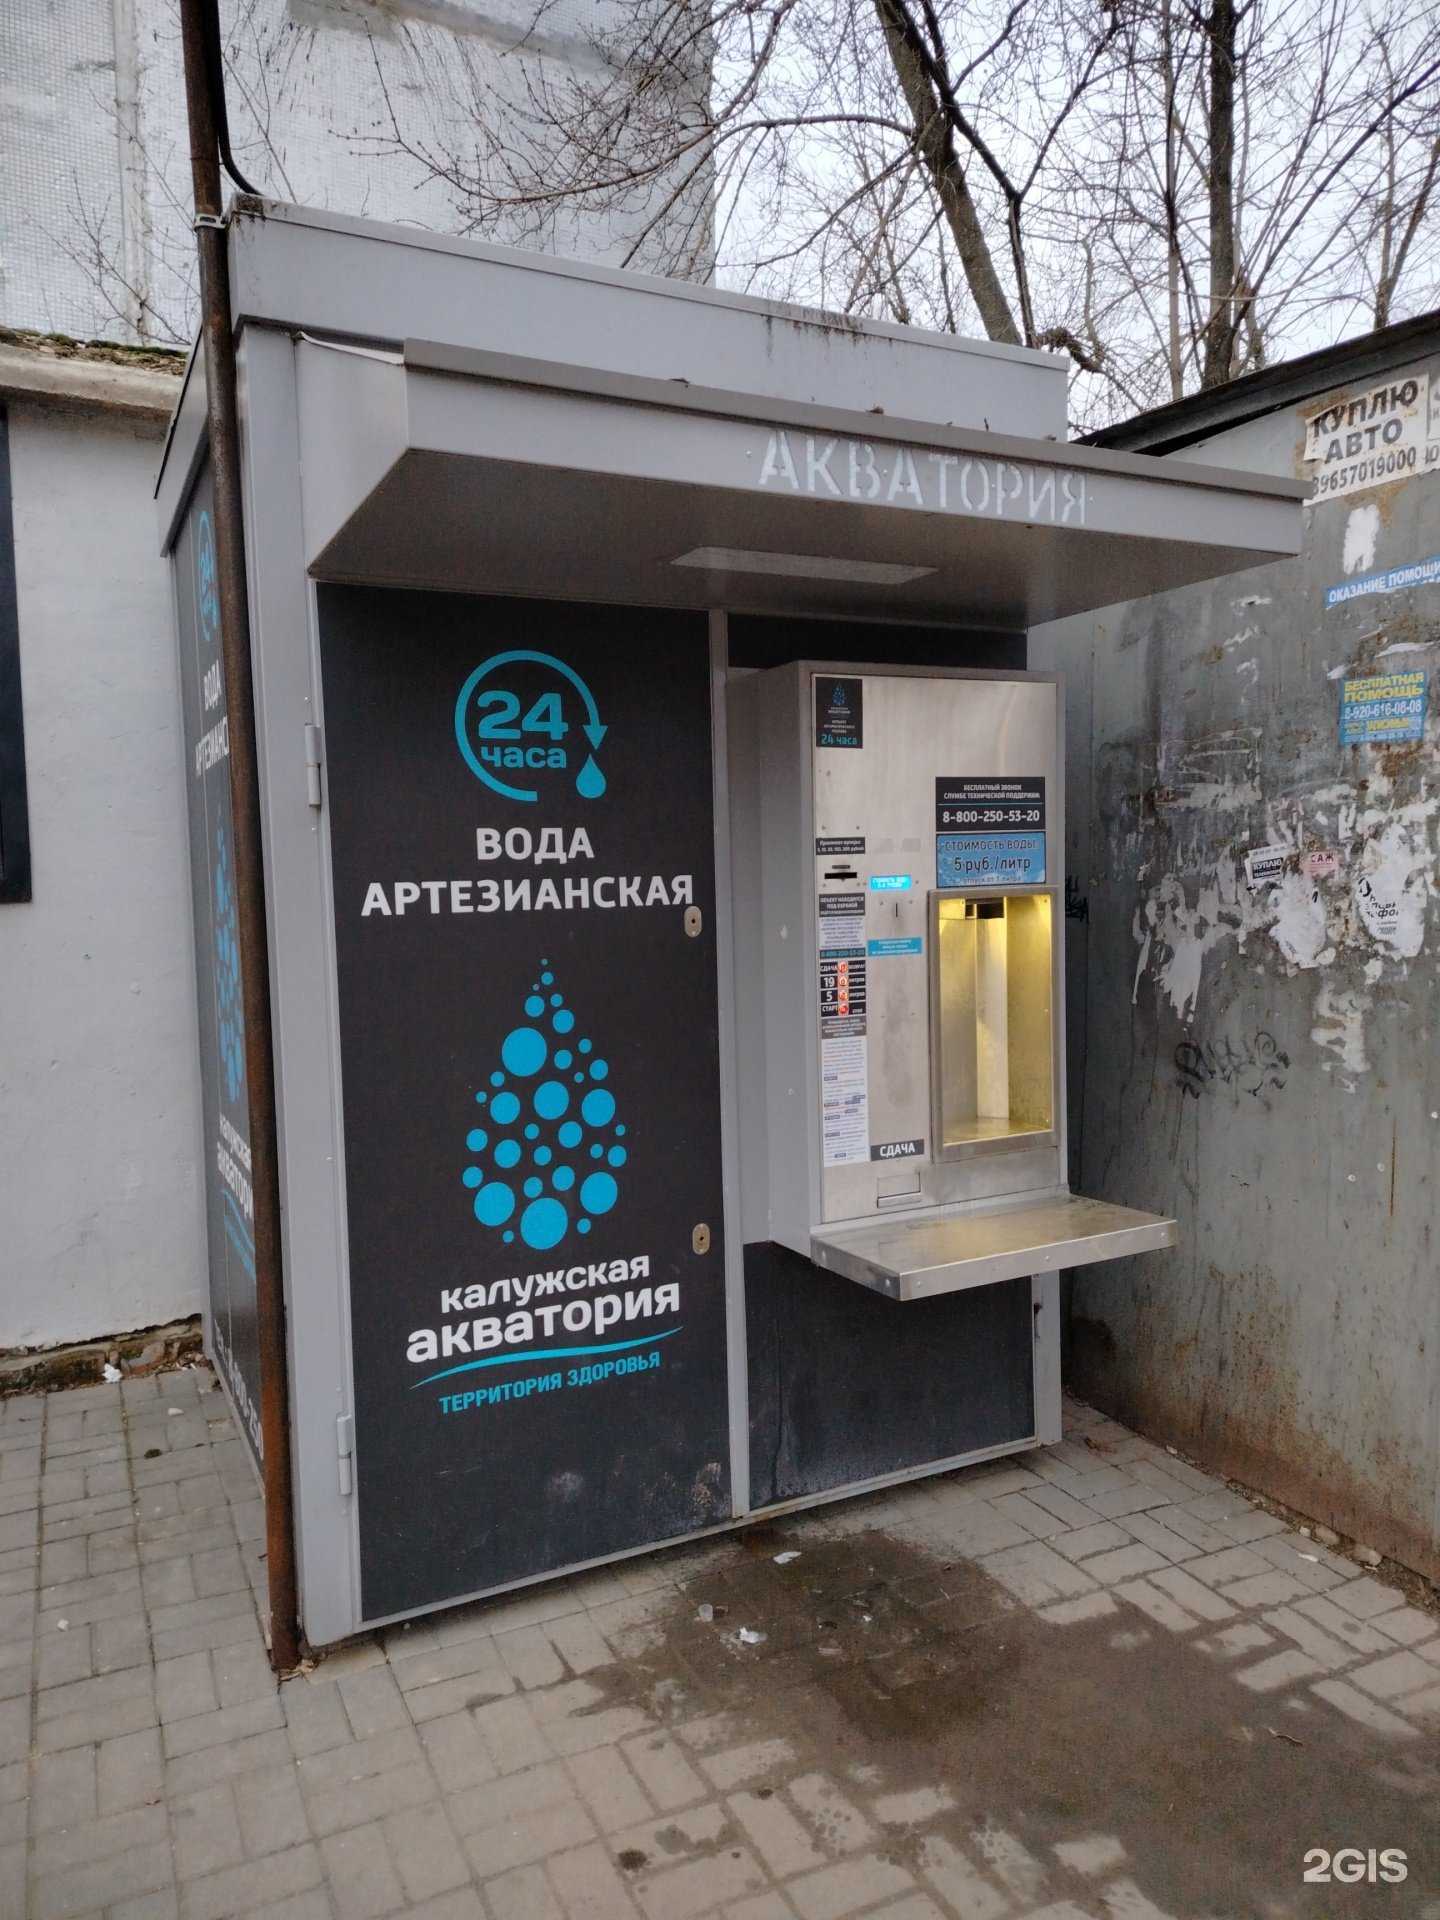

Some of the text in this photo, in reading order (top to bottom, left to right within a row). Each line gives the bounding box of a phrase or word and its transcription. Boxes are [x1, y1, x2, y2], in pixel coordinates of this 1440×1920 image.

[1313, 380, 1419, 438] КУПЛЮ
[1324, 418, 1403, 464] АВТО
[758, 431, 1087, 525] АКВАТОРИЯ
[1329, 576, 1386, 603] ОКАЗАНИЕ
[477, 690, 569, 740] 24
[480, 745, 567, 769] часа
[942, 810, 1040, 823] 8-800-250-53-20
[476, 826, 595, 864] ВОДА
[945, 840, 1005, 851] СТОИМОСТЬ
[954, 856, 1031, 874] 5 руб./литр
[1253, 859, 1282, 870] КУПЛЮ
[360, 875, 694, 917] АРТЕЗИАНСКАЯ
[823, 976, 836, 988] 19
[826, 990, 833, 1002] 5
[879, 1142, 916, 1159] СДАЧА
[440, 1255, 650, 1314] калужская
[406, 1282, 680, 1363] акватория
[438, 1351, 661, 1414] ТЕРРИТОРИЯ ЗДОРОВЬЯ
